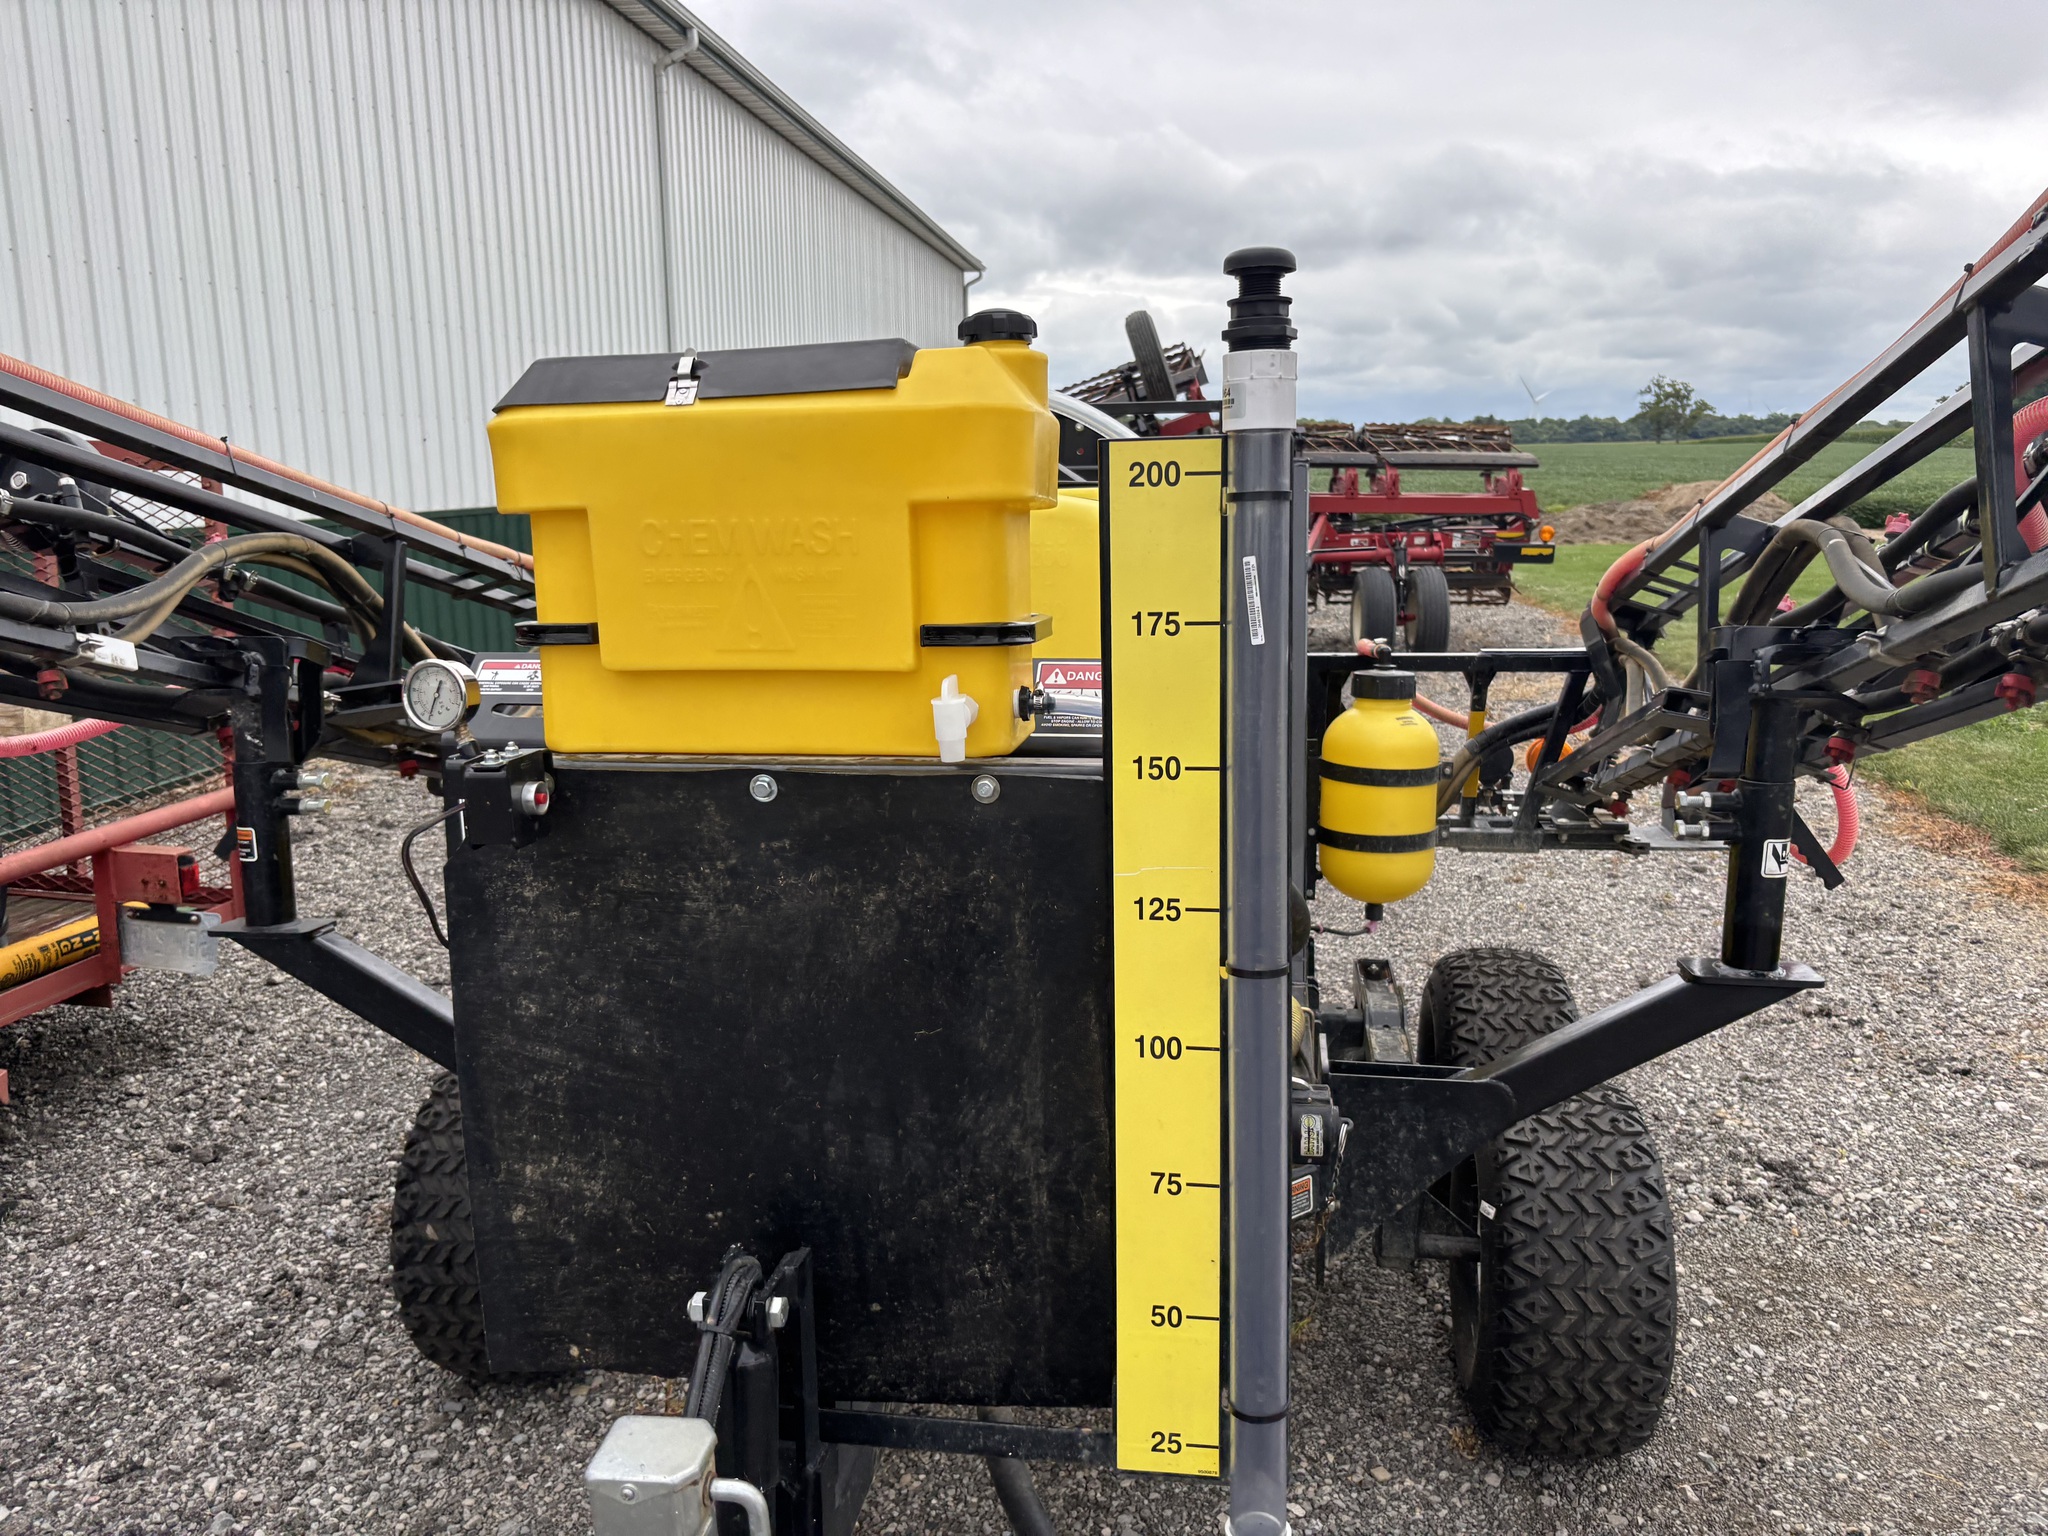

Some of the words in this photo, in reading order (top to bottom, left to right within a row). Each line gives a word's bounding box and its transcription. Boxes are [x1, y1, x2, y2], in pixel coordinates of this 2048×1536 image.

[1128, 460, 1181, 488] 200
[641, 517, 742, 556] CHEM
[749, 515, 860, 556] WASH
[1131, 611, 1181, 637] 175
[1132, 755, 1181, 781] 150
[1133, 896, 1182, 922] 125
[1134, 1034, 1182, 1061] 100
[1150, 1171, 1182, 1196] 75
[1150, 1304, 1183, 1329] 50
[1150, 1431, 1182, 1455] 25
